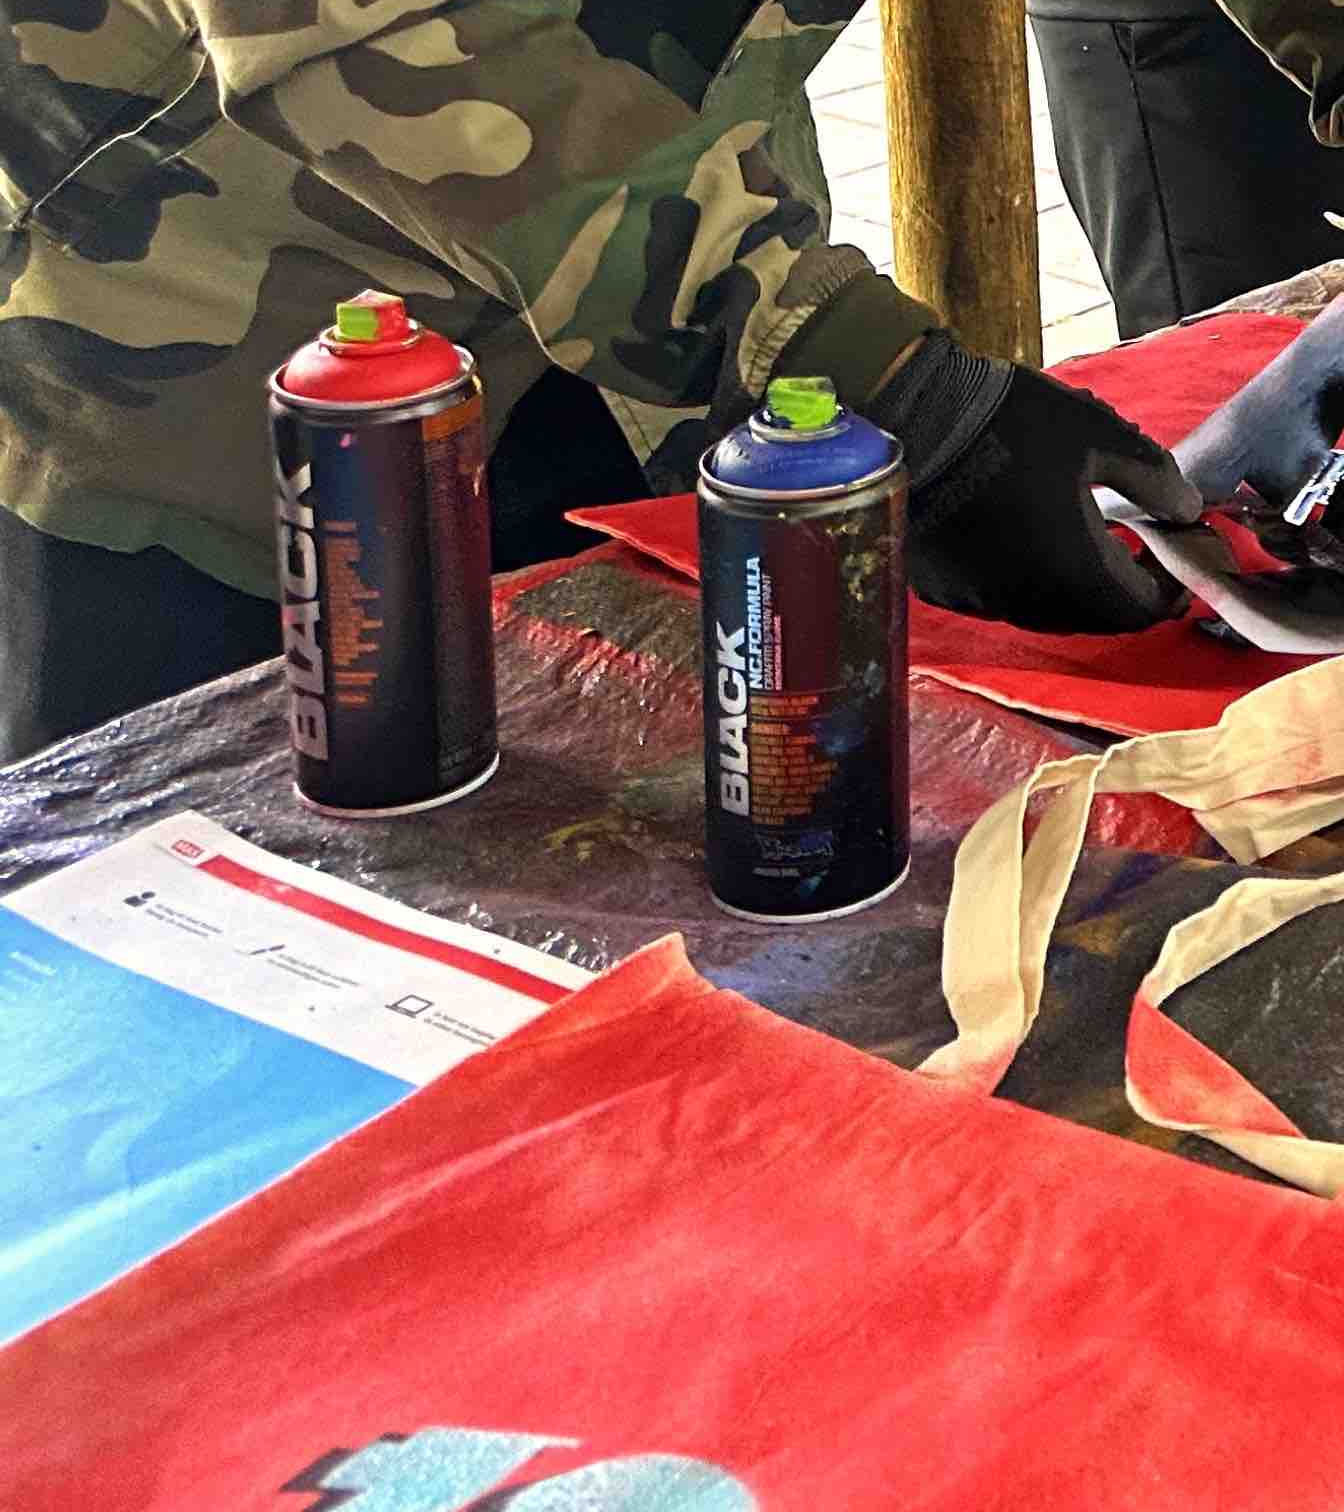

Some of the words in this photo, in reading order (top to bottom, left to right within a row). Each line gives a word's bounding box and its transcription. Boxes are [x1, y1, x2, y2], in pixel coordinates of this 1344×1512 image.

[275, 454, 329, 760] BLACK
[746, 557, 762, 654] FORMULA
[716, 620, 750, 817] BLACK
